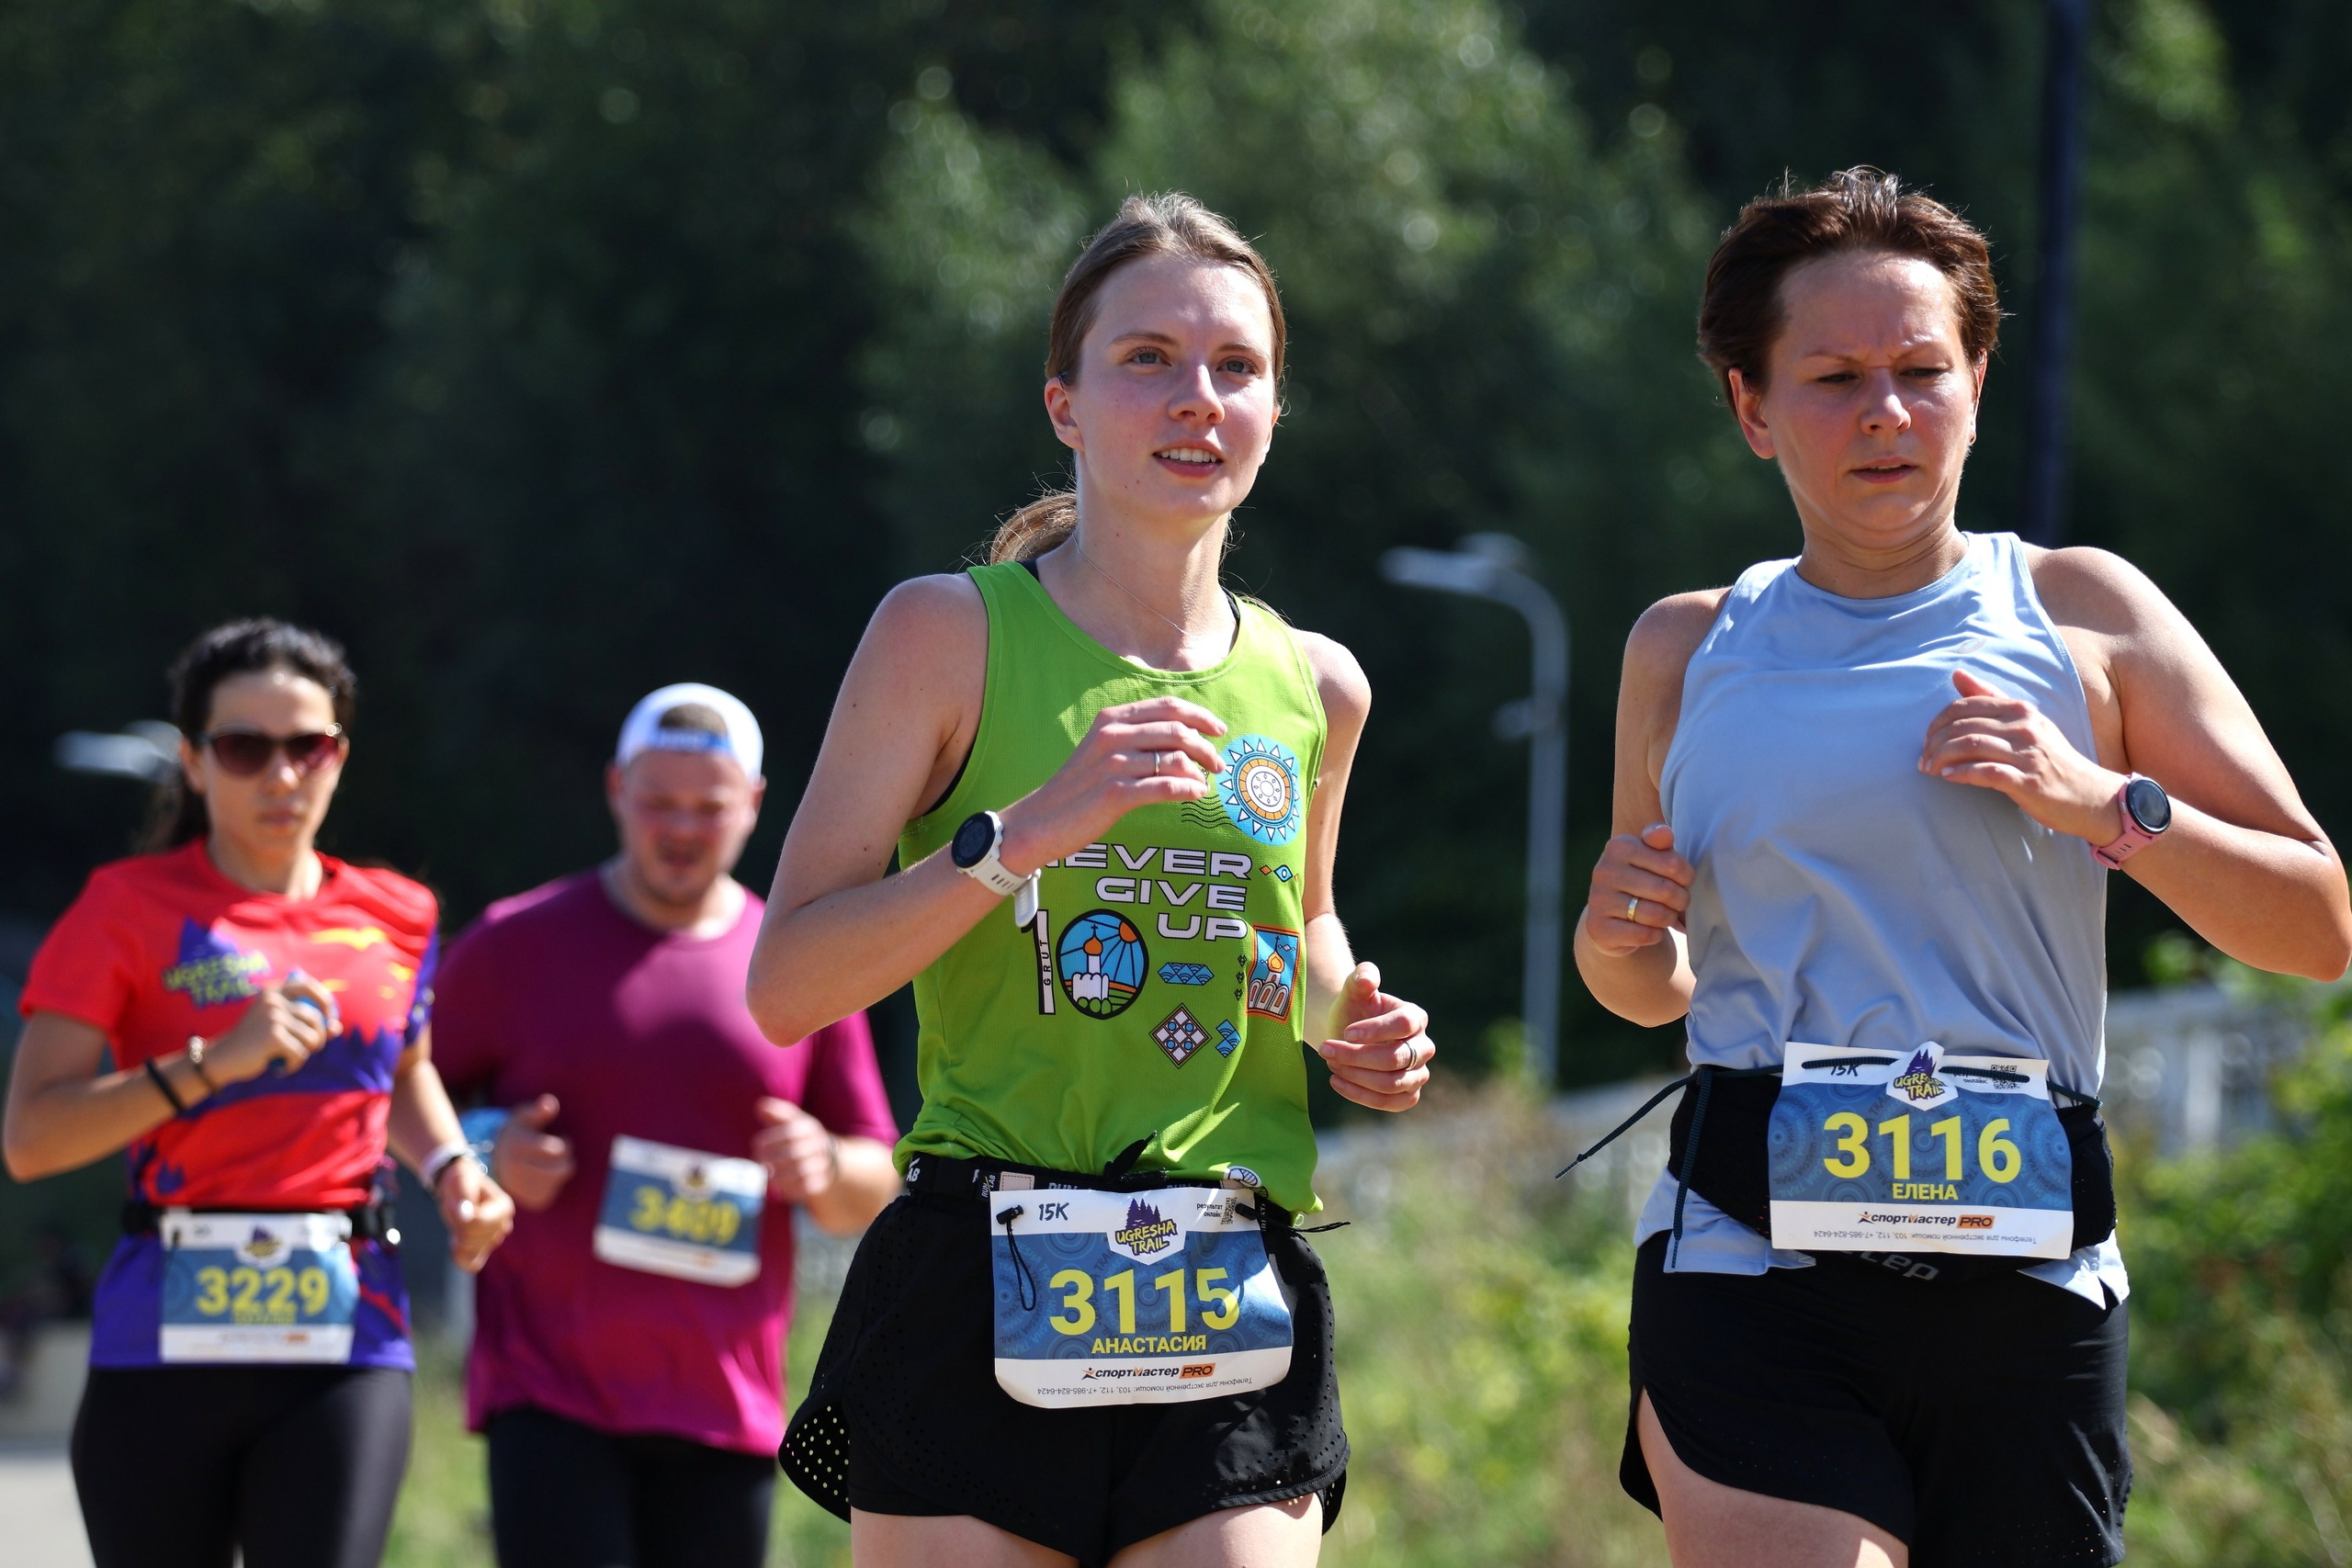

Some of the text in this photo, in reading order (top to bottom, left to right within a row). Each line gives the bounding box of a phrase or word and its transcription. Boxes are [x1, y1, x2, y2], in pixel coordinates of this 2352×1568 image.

[1045, 842, 1252, 880] EVER
[1095, 875, 1248, 912] GIVE
[1157, 912, 1248, 942] UP
[1039, 940, 1051, 986] GRUT
[1906, 1083, 1944, 1100] TRAIL
[1823, 1111, 2021, 1183] 3116
[1893, 1183, 1959, 1201] ЕЛЕНА
[1039, 1202, 1069, 1221] 15K
[1960, 1217, 1993, 1226] PRO
[1115, 1220, 1177, 1244] UGRESHA
[2001, 1235, 2037, 1244] Телефоны
[1130, 1237, 1169, 1256] TRAIL
[196, 1266, 330, 1315] 3229
[1049, 1268, 1239, 1336] 3115
[1091, 1336, 1207, 1354] АНАСТАСИЯ
[1182, 1366, 1213, 1377] PRO
[1167, 1382, 1204, 1392] экстренной
[1219, 1377, 1252, 1387] Телефоны
